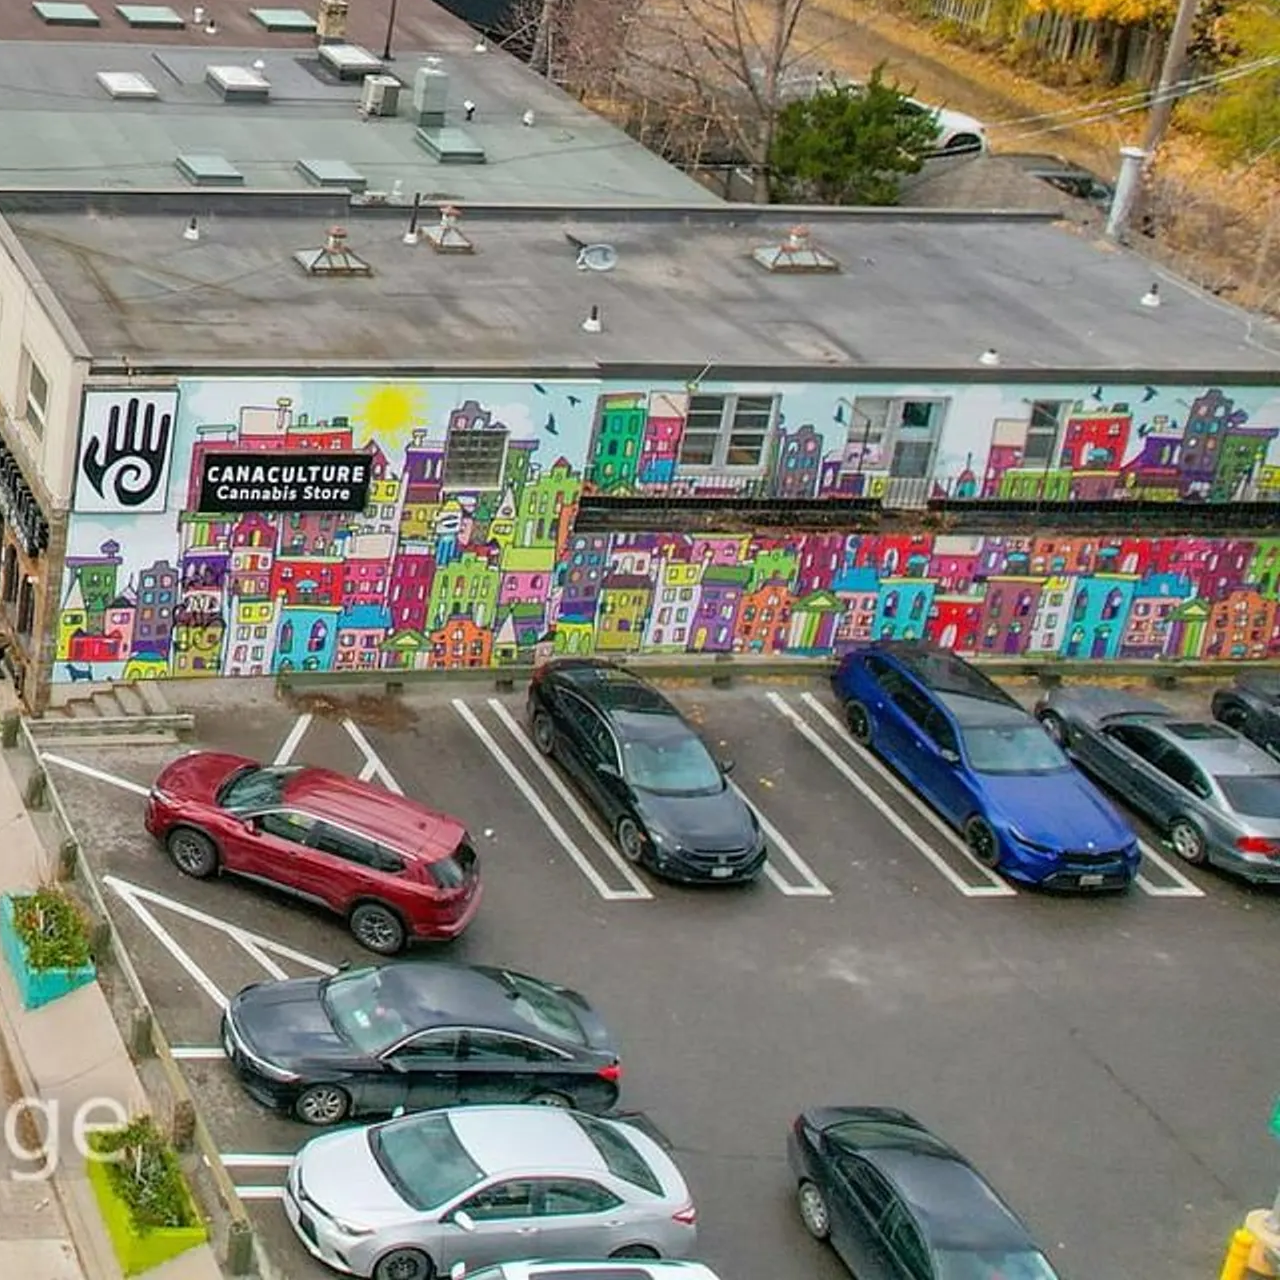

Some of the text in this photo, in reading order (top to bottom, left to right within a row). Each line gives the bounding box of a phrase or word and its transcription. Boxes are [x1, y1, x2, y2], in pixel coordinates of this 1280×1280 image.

[206, 465, 366, 484] CANACULTURE
[216, 485, 351, 501] Cannabis Store
